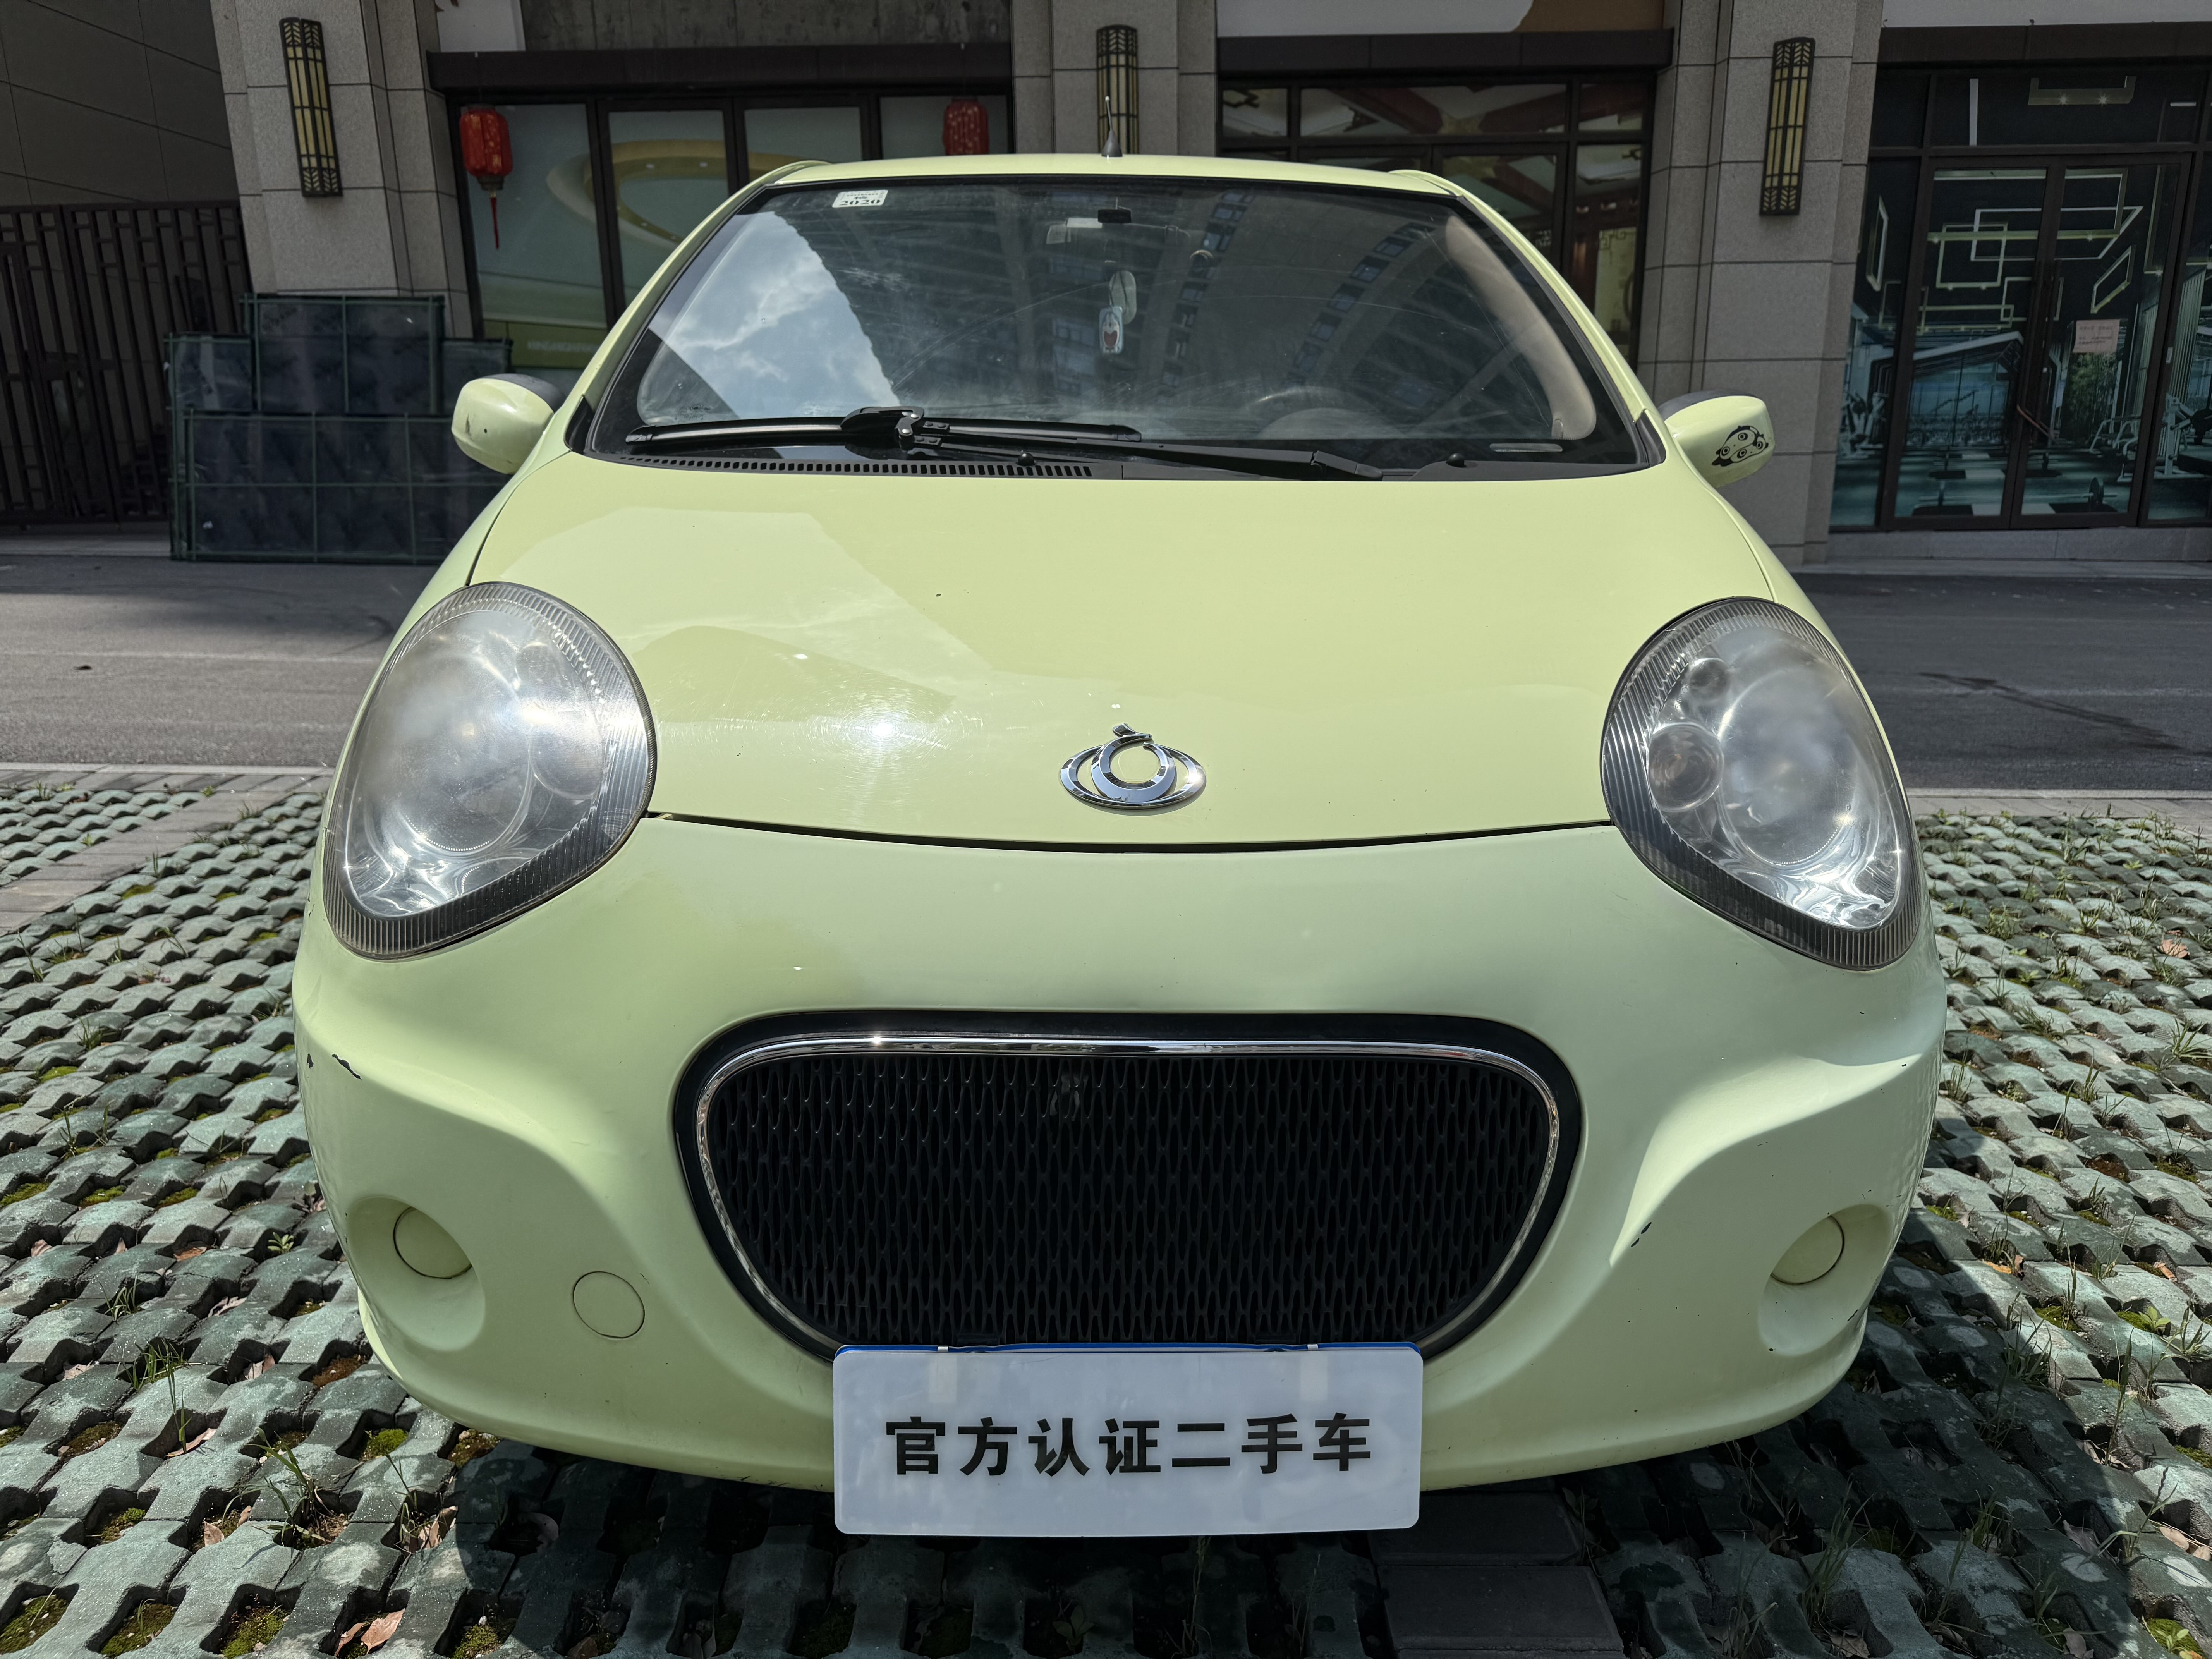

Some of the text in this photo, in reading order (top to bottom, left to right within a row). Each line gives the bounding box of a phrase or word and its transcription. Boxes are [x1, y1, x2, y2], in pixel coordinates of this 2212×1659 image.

[886, 1412, 1372, 1477] 官方认证二手车
